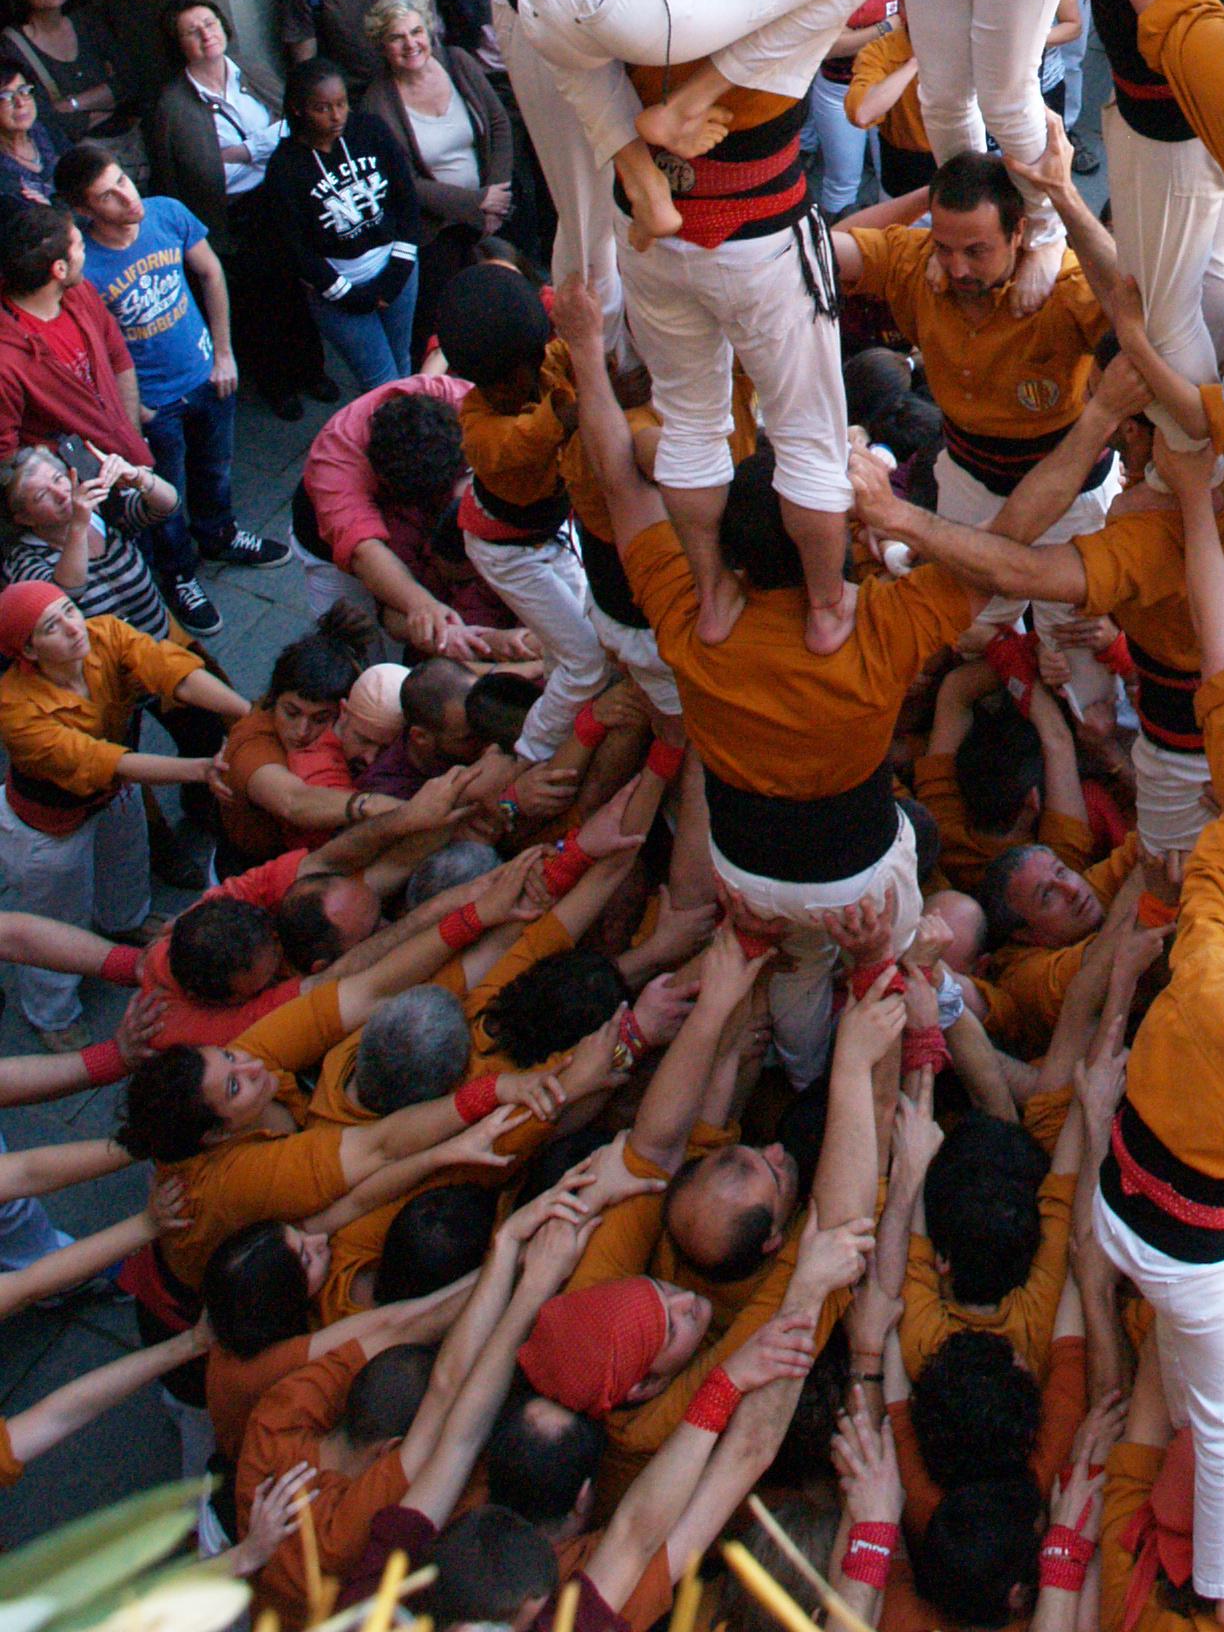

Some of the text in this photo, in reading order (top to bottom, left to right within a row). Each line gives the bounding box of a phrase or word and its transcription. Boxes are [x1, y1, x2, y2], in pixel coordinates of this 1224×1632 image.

[310, 156, 377, 199] THE CITY
[321, 171, 386, 234] NY
[101, 247, 181, 302] CALIFORNIA
